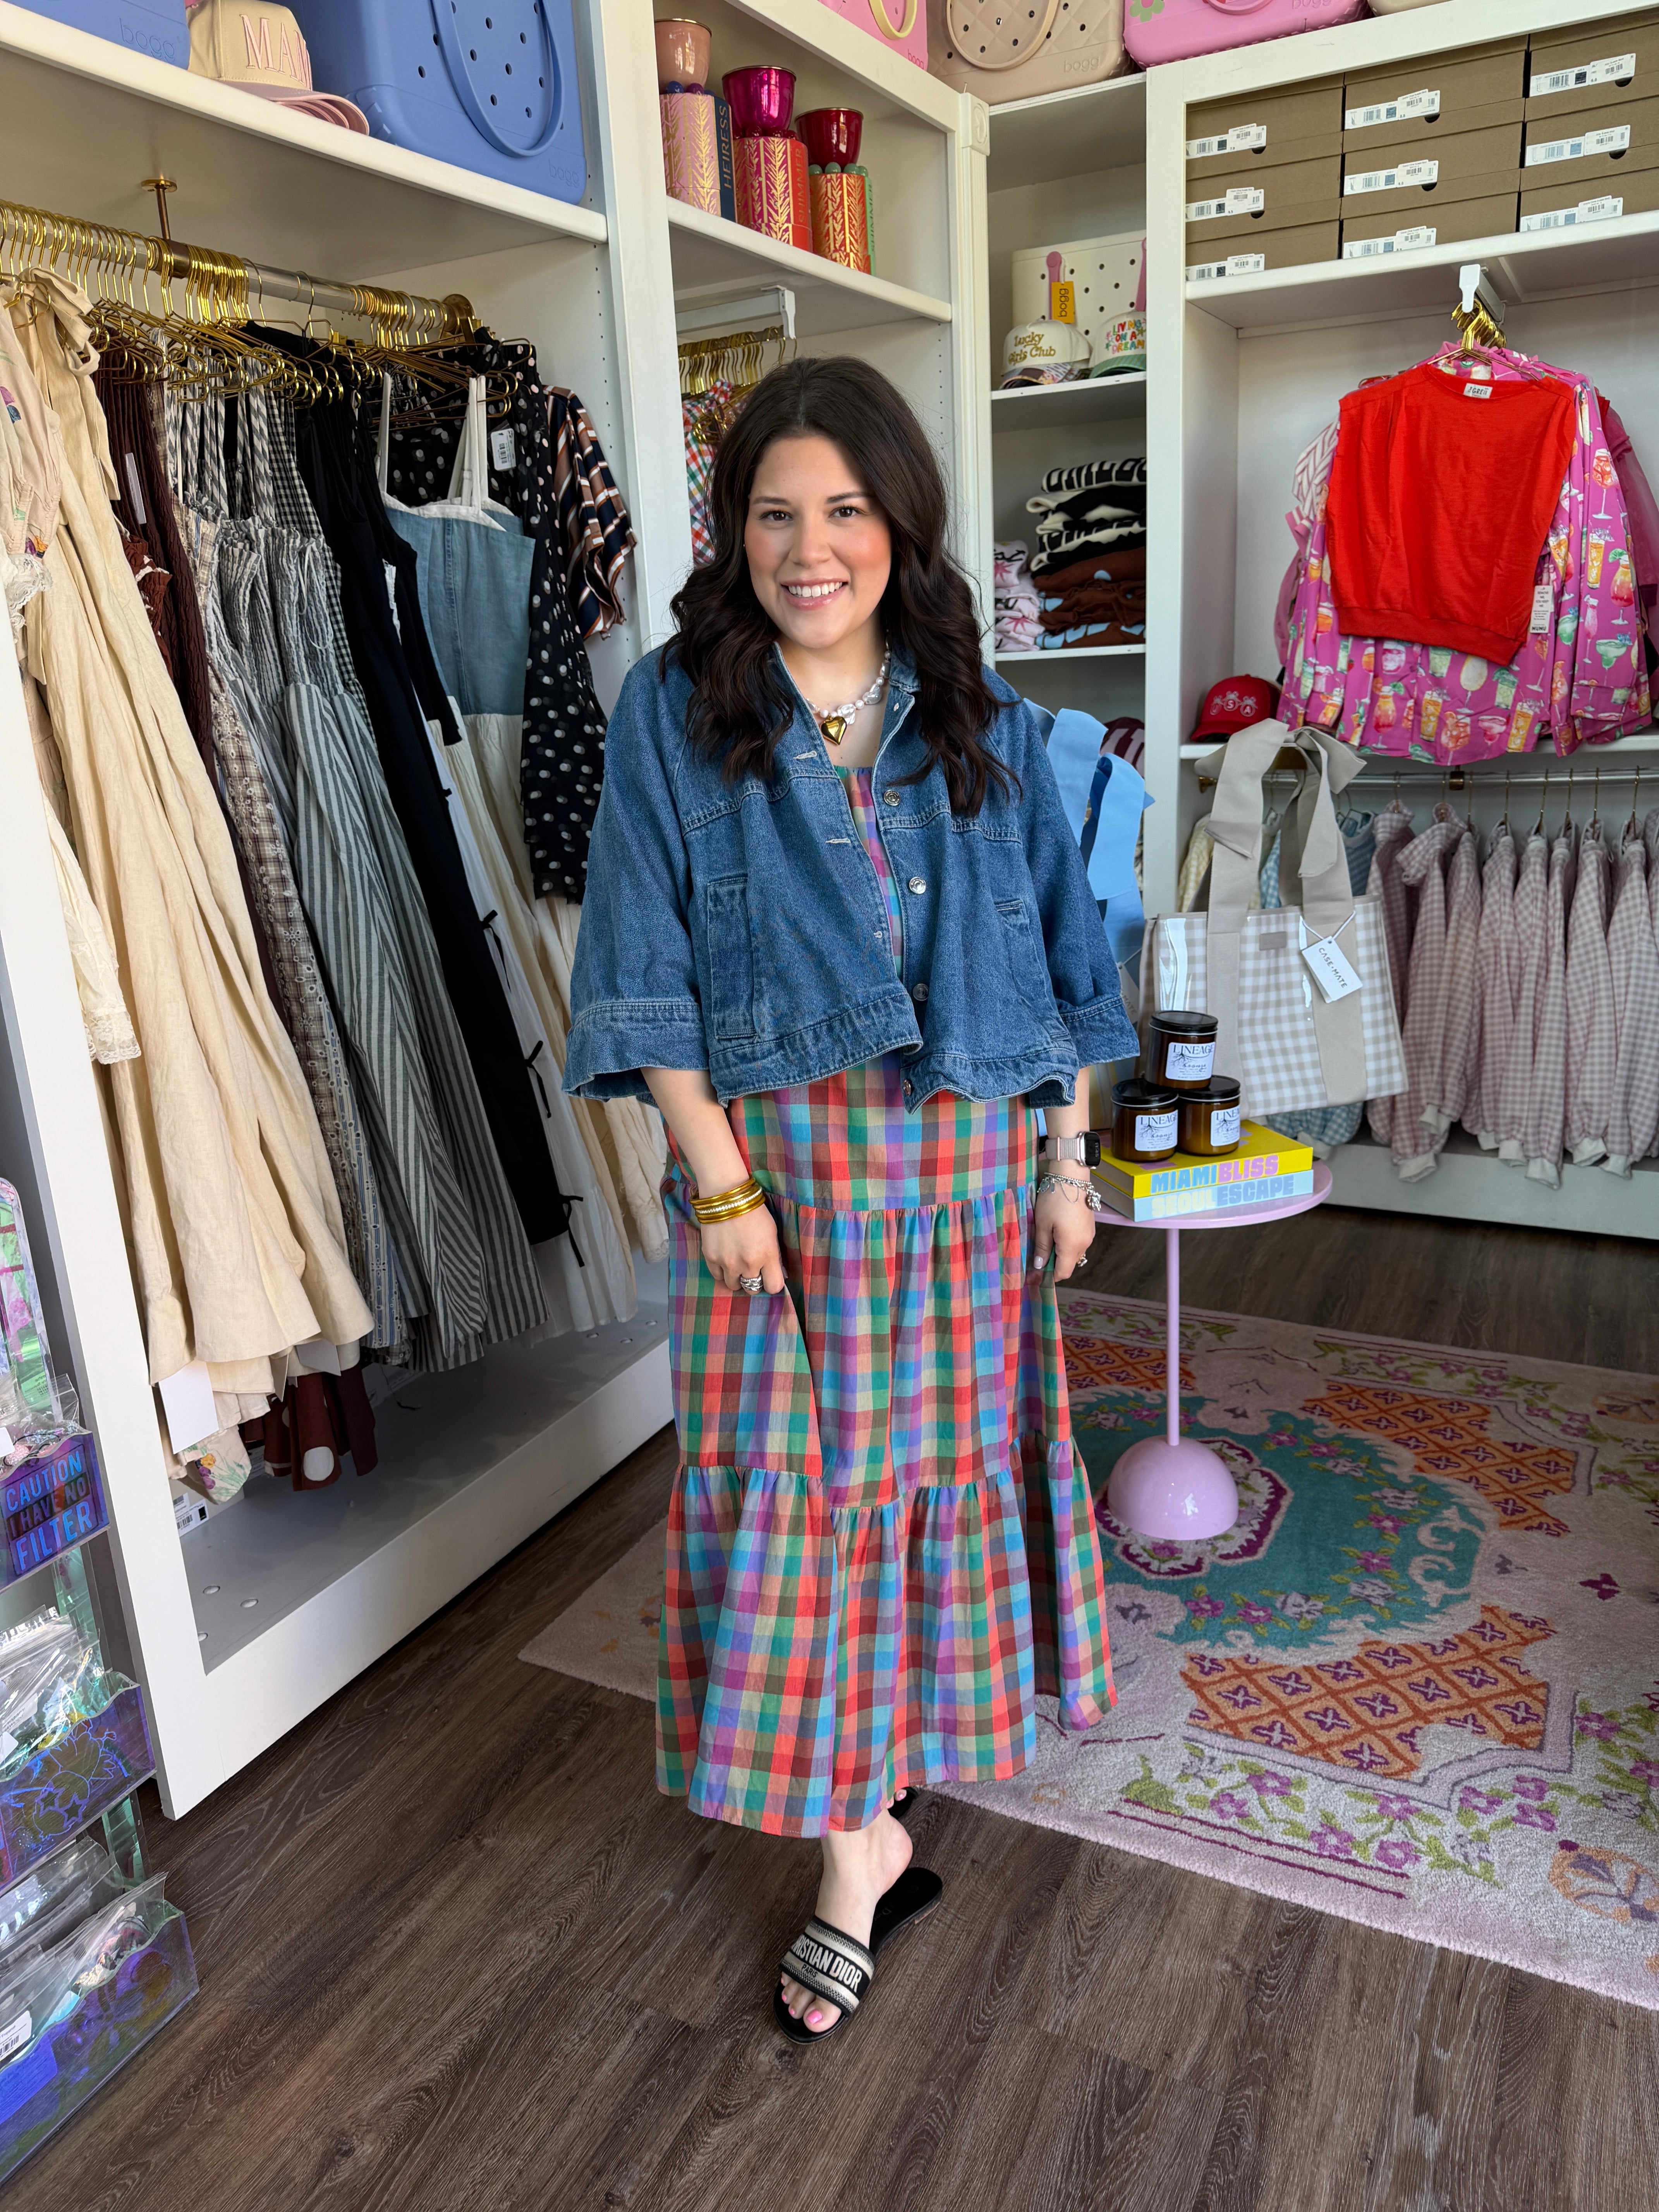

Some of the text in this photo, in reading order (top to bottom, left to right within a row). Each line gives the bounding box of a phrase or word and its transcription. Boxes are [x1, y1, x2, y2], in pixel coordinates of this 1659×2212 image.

[119, 17, 175, 63] bogg
[1064, 57, 1099, 73] bogg
[719, 105, 732, 189] HEIRESS
[548, 159, 580, 189] bogg
[795, 148, 805, 223] SHIMMER
[1058, 288, 1069, 317] bogg
[1029, 344, 1056, 358] Club
[1111, 339, 1145, 354] DREAM
[1130, 331, 1137, 341] A
[1151, 1154, 1279, 1195] MIAMI BLISS
[1152, 1175, 1294, 1218] SEOUL ESCAPE
[6, 1451, 82, 1511] CAUTION
[10, 1477, 87, 1538] I HAVE NO
[16, 1501, 92, 1571] FILTER
[801, 1964, 818, 1978] PARIS
[829, 1956, 862, 1993] DIOR
